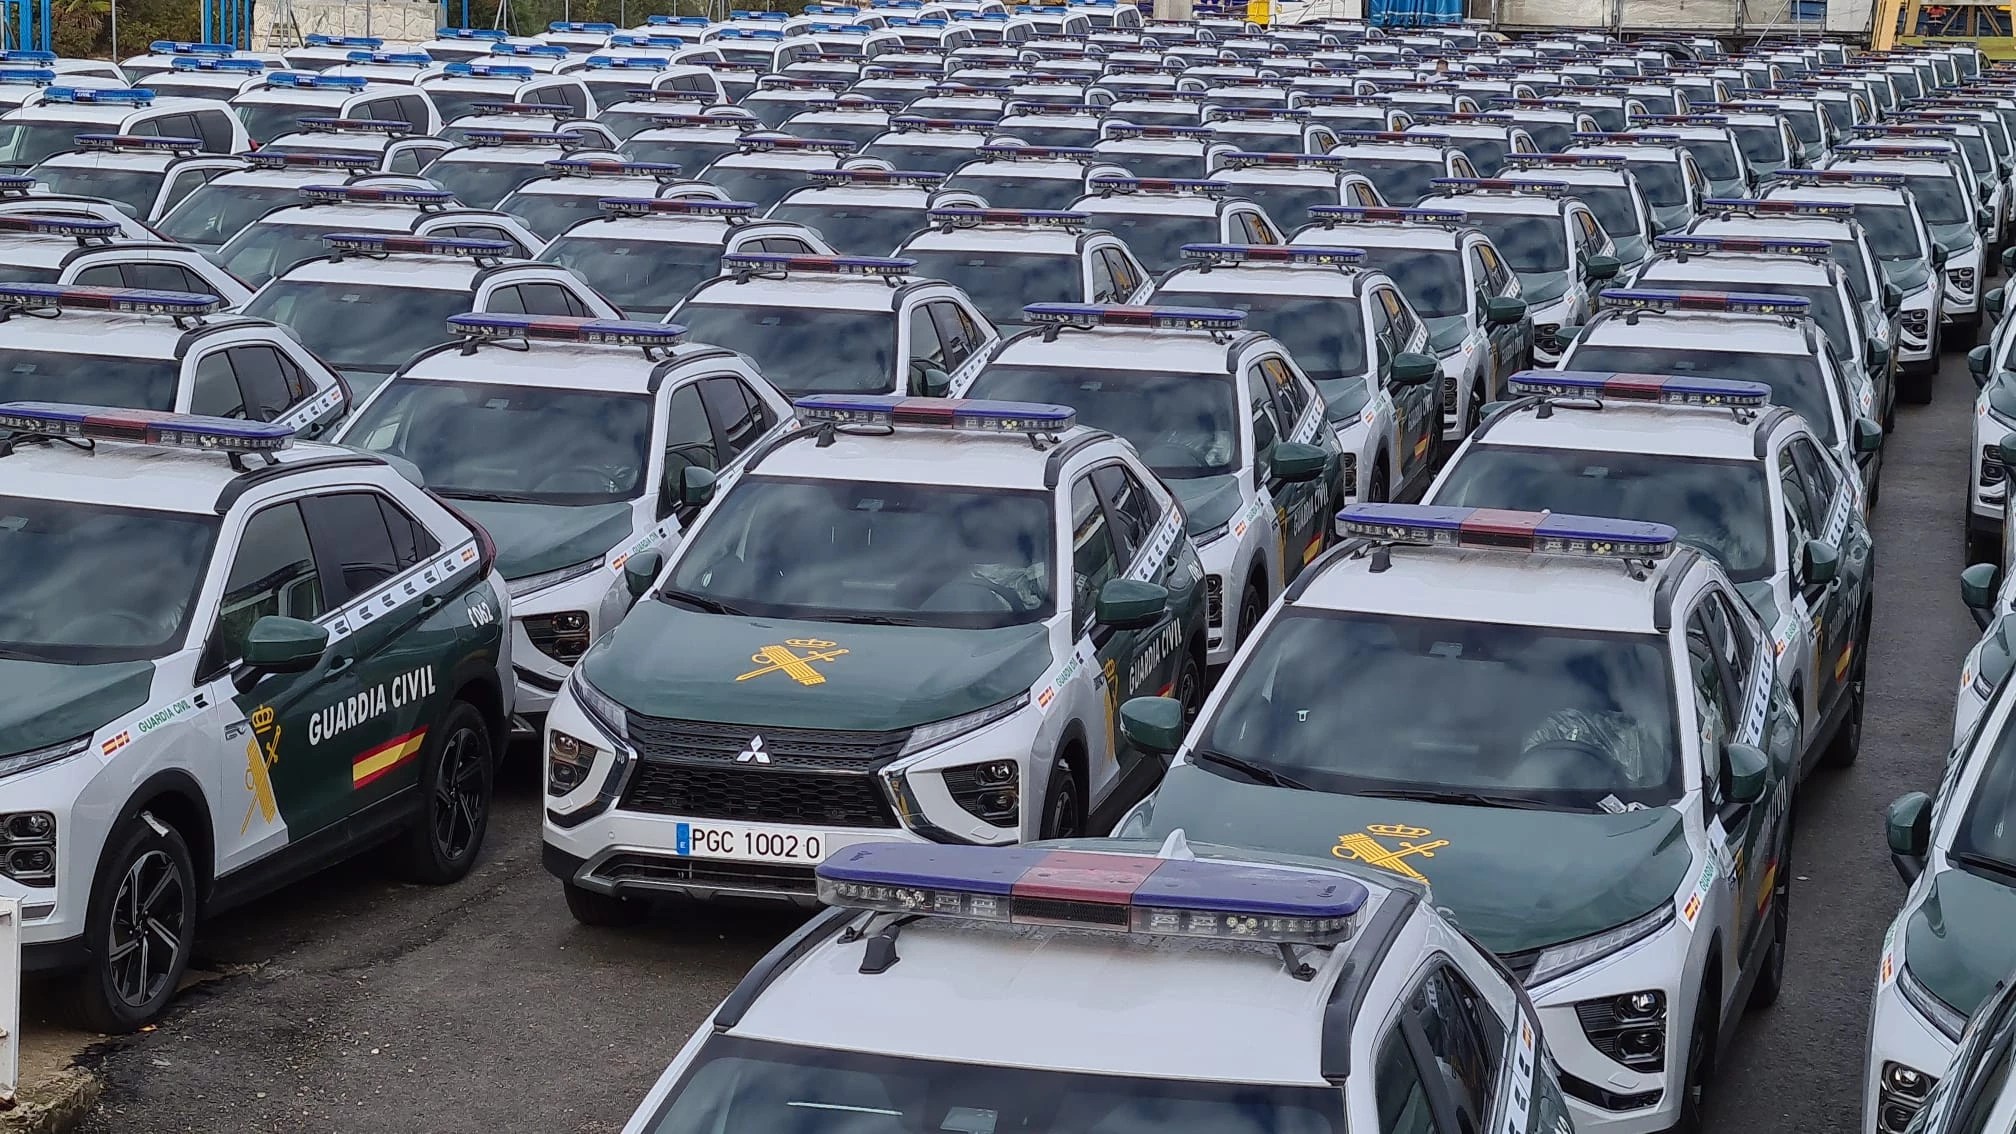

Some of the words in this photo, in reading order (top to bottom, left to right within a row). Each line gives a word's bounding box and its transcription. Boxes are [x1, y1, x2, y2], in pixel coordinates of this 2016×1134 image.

[1129, 638, 1161, 696] GUARDIA
[1161, 617, 1183, 658] CIVIL
[138, 707, 176, 732] GUARDIA
[173, 699, 191, 714] CIVIL
[308, 684, 387, 746] GUARDIA
[391, 664, 437, 709] CIVIL
[692, 828, 734, 853] PGC
[745, 832, 798, 858] 1002
[806, 836, 820, 859] 0
